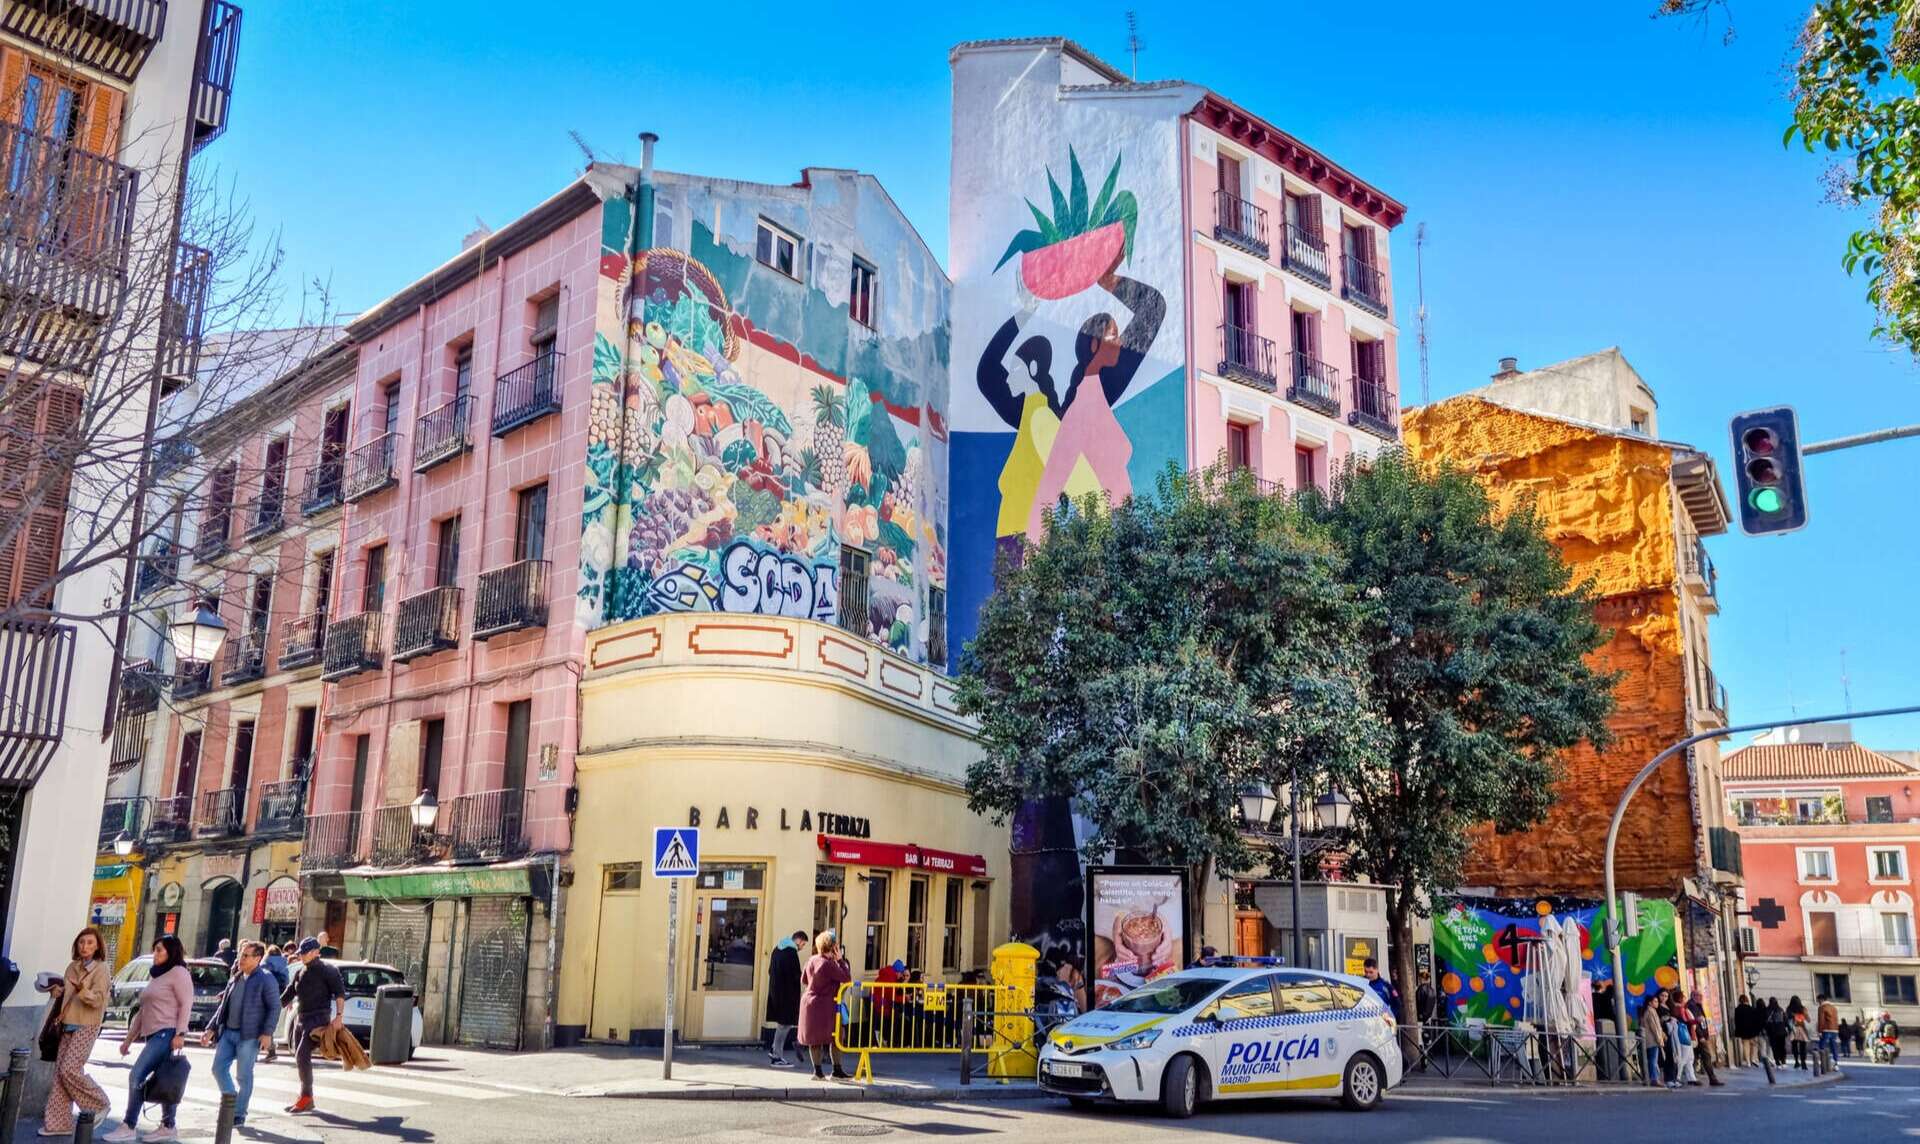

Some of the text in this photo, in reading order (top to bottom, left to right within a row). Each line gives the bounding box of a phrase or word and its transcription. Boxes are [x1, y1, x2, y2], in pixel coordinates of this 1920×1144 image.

[689, 805, 871, 838] BAR LA TERRAZA
[905, 853, 954, 869] BAR LA TERRAZA
[1463, 942, 1477, 950] YOU
[1226, 1033, 1319, 1064] POLICÍA
[1221, 1062, 1281, 1076] MUNICIPAL
[1220, 1075, 1251, 1084] MADRID
